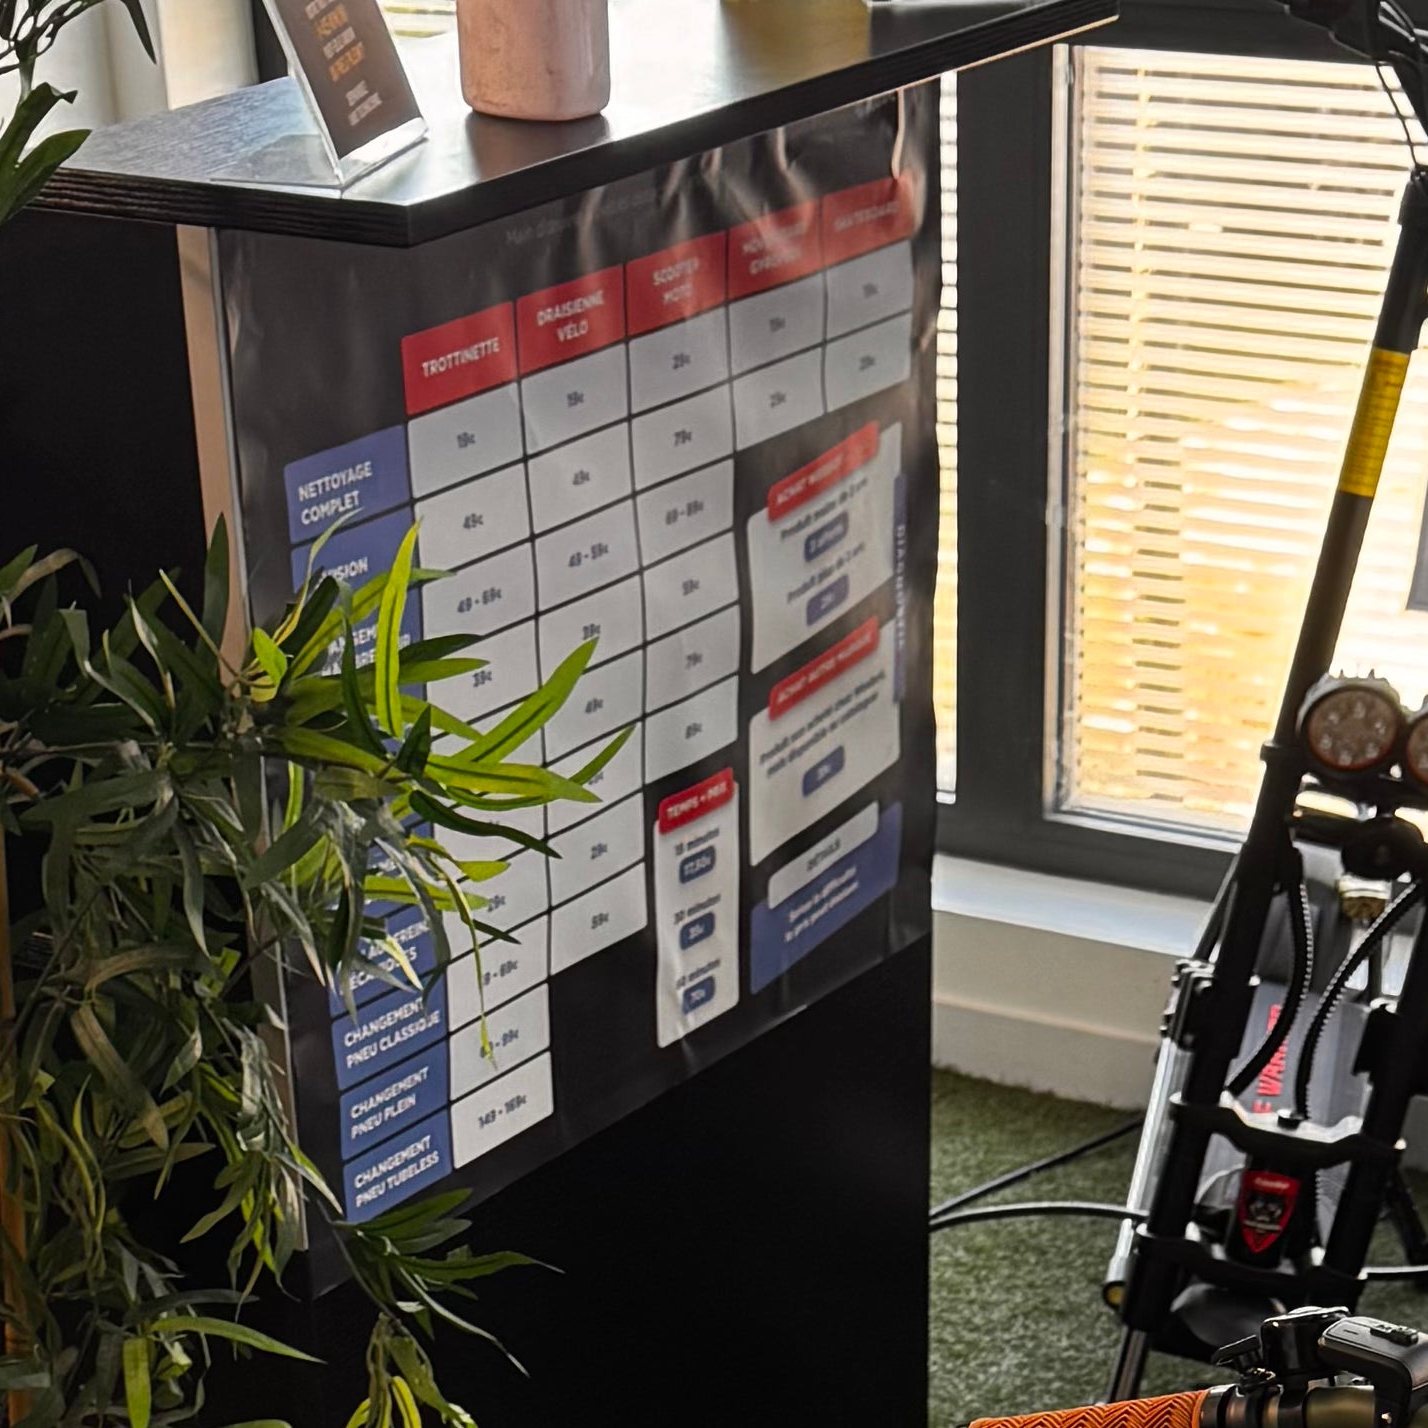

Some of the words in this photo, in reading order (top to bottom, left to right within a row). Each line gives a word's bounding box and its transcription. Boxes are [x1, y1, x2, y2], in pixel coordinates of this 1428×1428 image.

[536, 290, 605, 326] DRAISIENNE
[421, 337, 500, 378] TROTTINETTE
[298, 461, 373, 502] NETTOYAGE
[301, 490, 360, 525] COMPLET
[344, 997, 424, 1047] CHANGEMENT
[347, 1042, 378, 1069] PNEU
[379, 1010, 441, 1051] CLASSIQUE
[350, 1066, 429, 1119] CHANGEMENT
[351, 1114, 383, 1140] PNEU
[384, 1093, 417, 1122] PLEIN
[354, 1134, 432, 1189] CHANGEMENT
[356, 1181, 387, 1208] PNEU
[387, 1150, 440, 1190] TUBELESS
